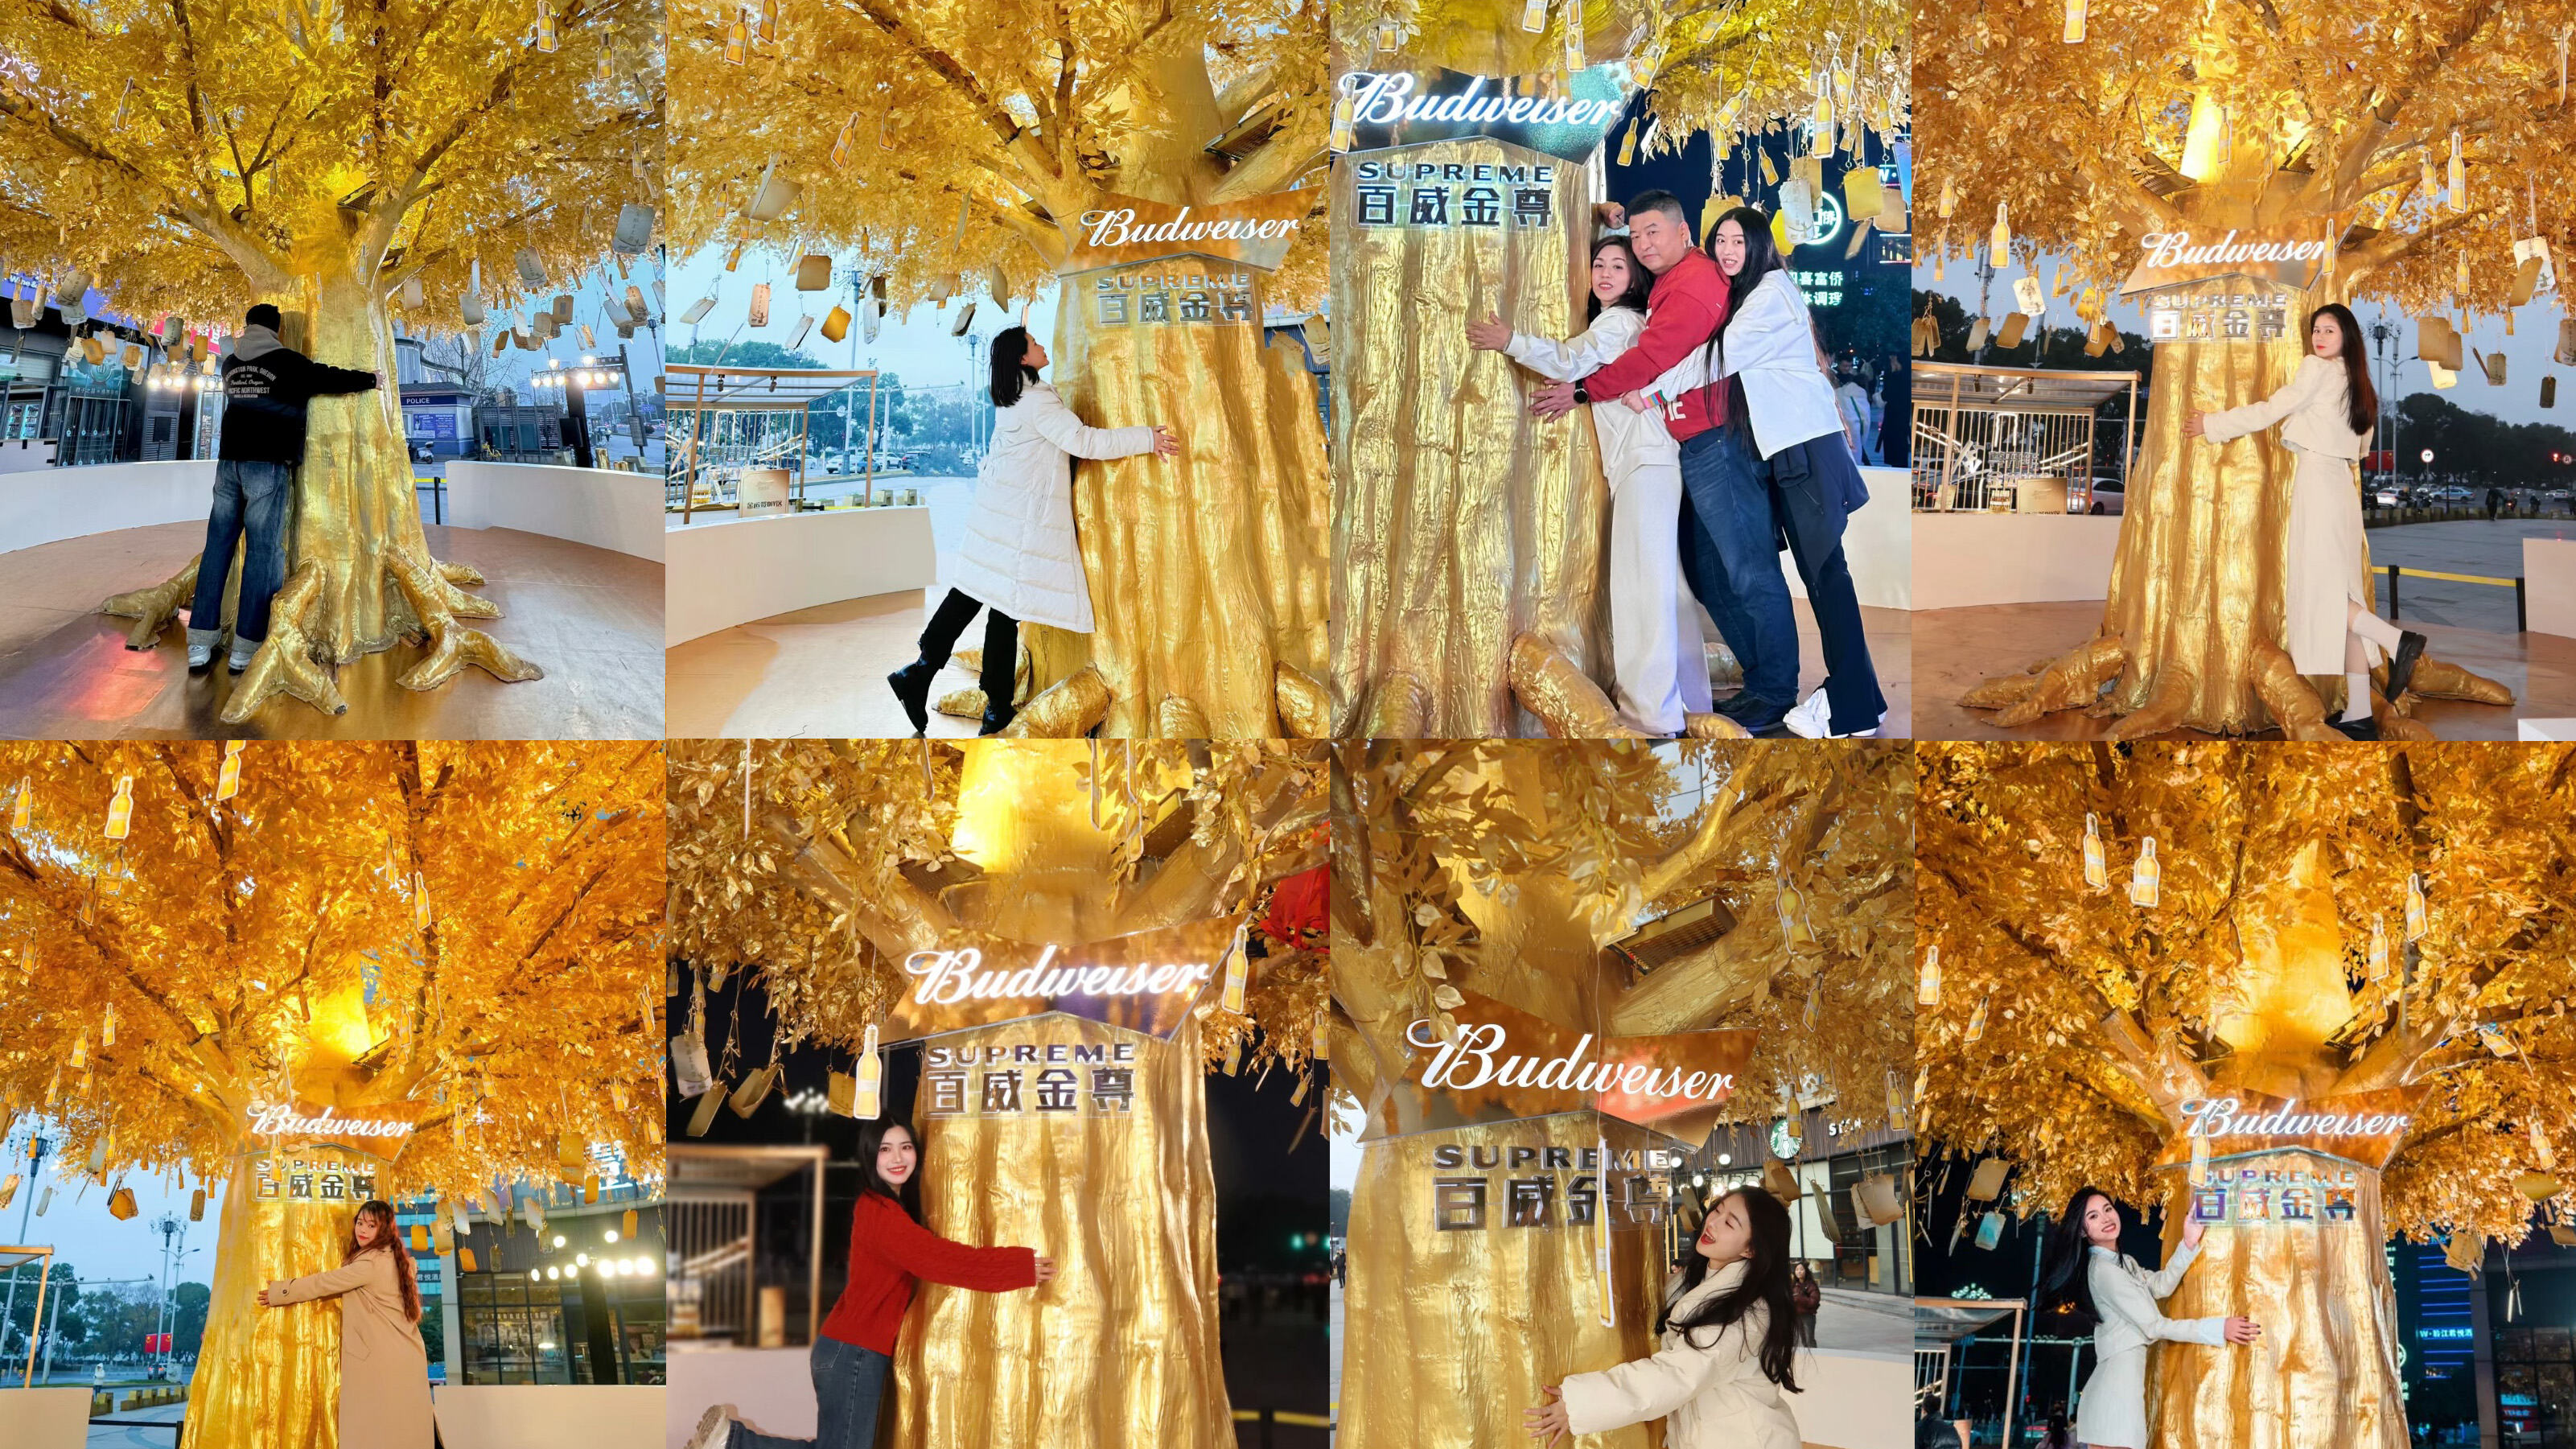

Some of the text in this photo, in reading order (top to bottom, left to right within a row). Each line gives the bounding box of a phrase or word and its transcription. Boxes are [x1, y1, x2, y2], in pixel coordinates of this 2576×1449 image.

[1338, 72, 1620, 125] Budweiser
[1358, 162, 1553, 183] SUPREME
[1357, 184, 1553, 228] 百威金尊
[1080, 206, 1299, 247] Budweiser
[1097, 274, 1250, 290] SUPREME
[1098, 291, 1252, 323] 百威金尊
[2154, 293, 2286, 309] SUPREME
[2152, 309, 2286, 339] 百威金尊
[905, 945, 1208, 1005] Budweiser
[928, 1044, 1135, 1067] SUPREME
[1406, 1019, 1734, 1100] Budweiser
[927, 1068, 1135, 1114] 百威金尊
[246, 1105, 414, 1138] Budweiser
[2179, 1097, 2408, 1138] Budweiser
[1433, 1145, 1670, 1171] SUPREME
[256, 1172, 376, 1200] 百威金尊
[1434, 1174, 1670, 1233] 百威金尊
[2194, 1188, 2357, 1221] 百威金尊
[417, 1273, 441, 1281] 君悦酒
